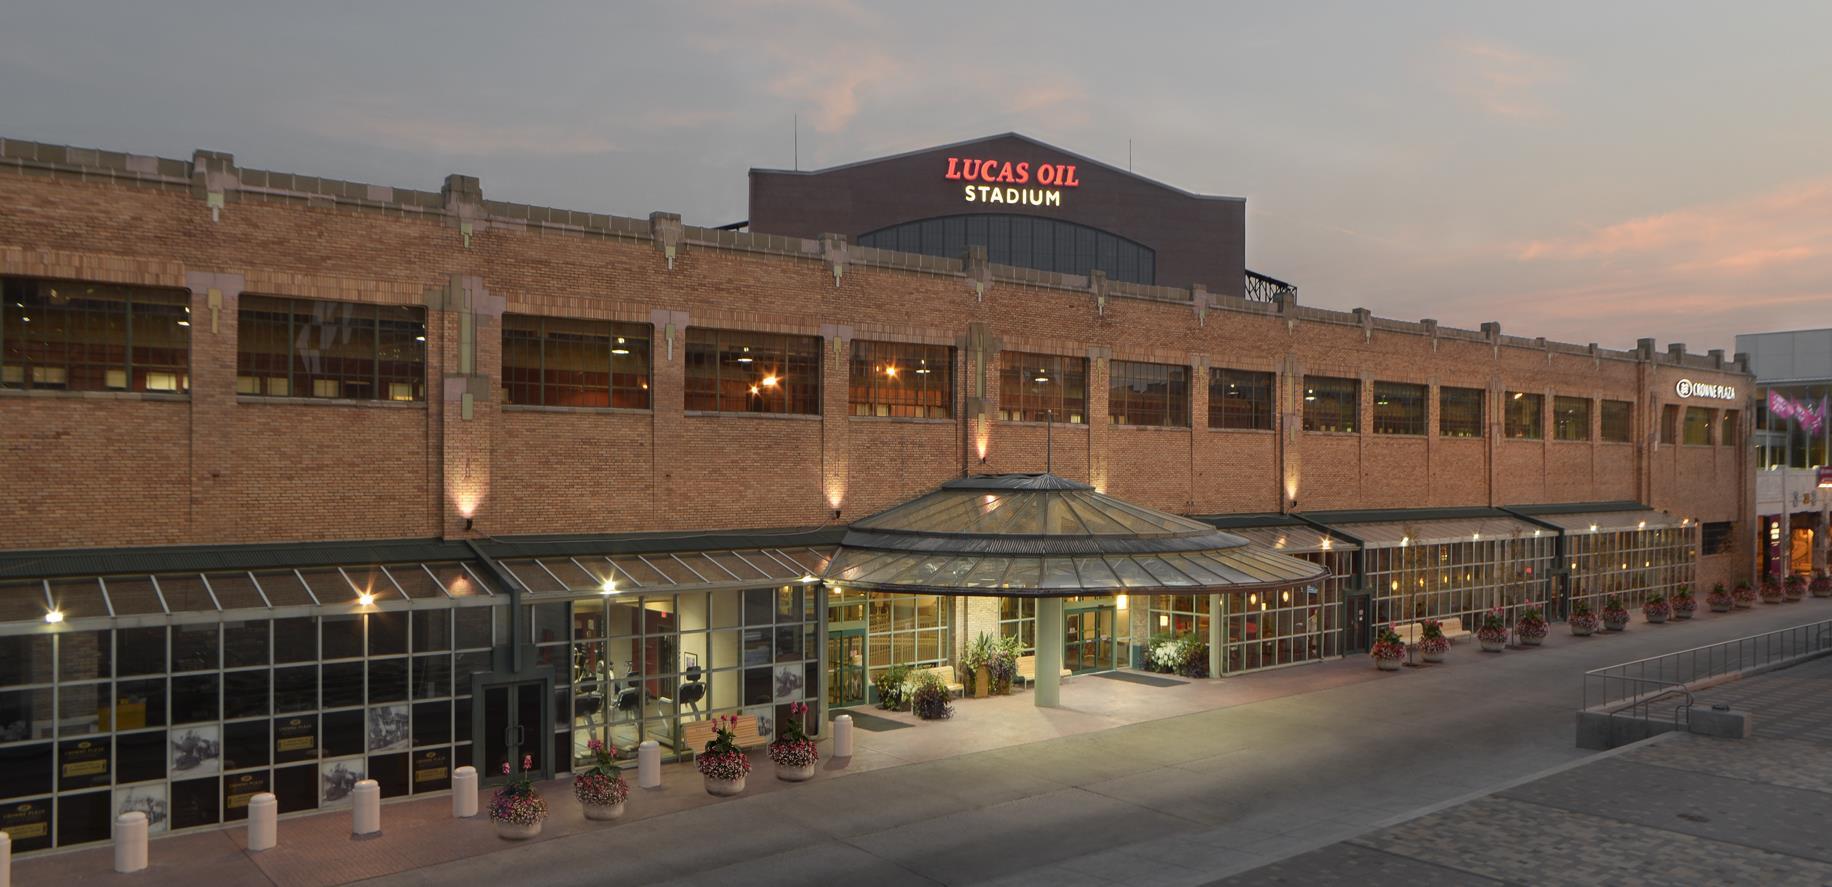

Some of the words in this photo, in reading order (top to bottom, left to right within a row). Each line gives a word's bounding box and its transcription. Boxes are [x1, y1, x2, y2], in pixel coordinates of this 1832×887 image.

[945, 157, 1030, 184] LUCAS
[1037, 163, 1079, 187] OIL
[965, 185, 1060, 207] STADIUM
[1693, 383, 1717, 398] CROWNE
[1717, 385, 1735, 399] PLAZA
